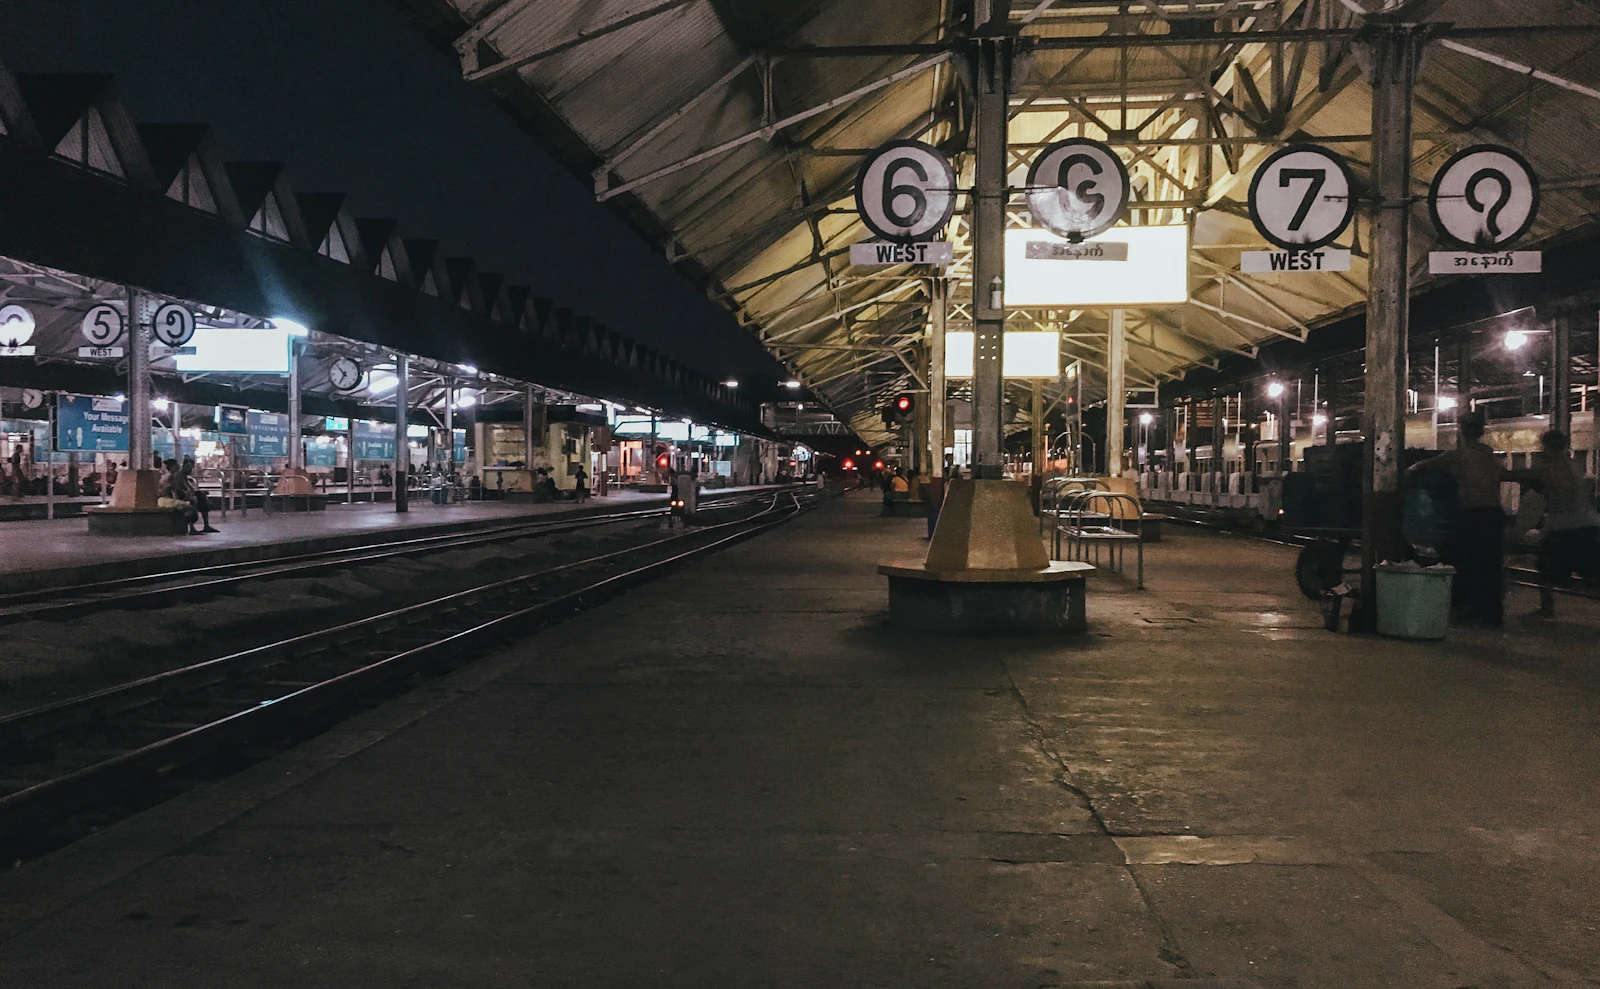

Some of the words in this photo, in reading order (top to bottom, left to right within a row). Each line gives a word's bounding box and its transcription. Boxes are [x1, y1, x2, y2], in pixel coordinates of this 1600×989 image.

[882, 157, 928, 227] 6
[1279, 168, 1326, 231] 7
[877, 245, 928, 263] WEST
[1270, 252, 1325, 271] WEST
[91, 310, 111, 340] 5
[90, 348, 113, 357] WEST
[83, 411, 100, 421] Your
[91, 423, 123, 434] Available
